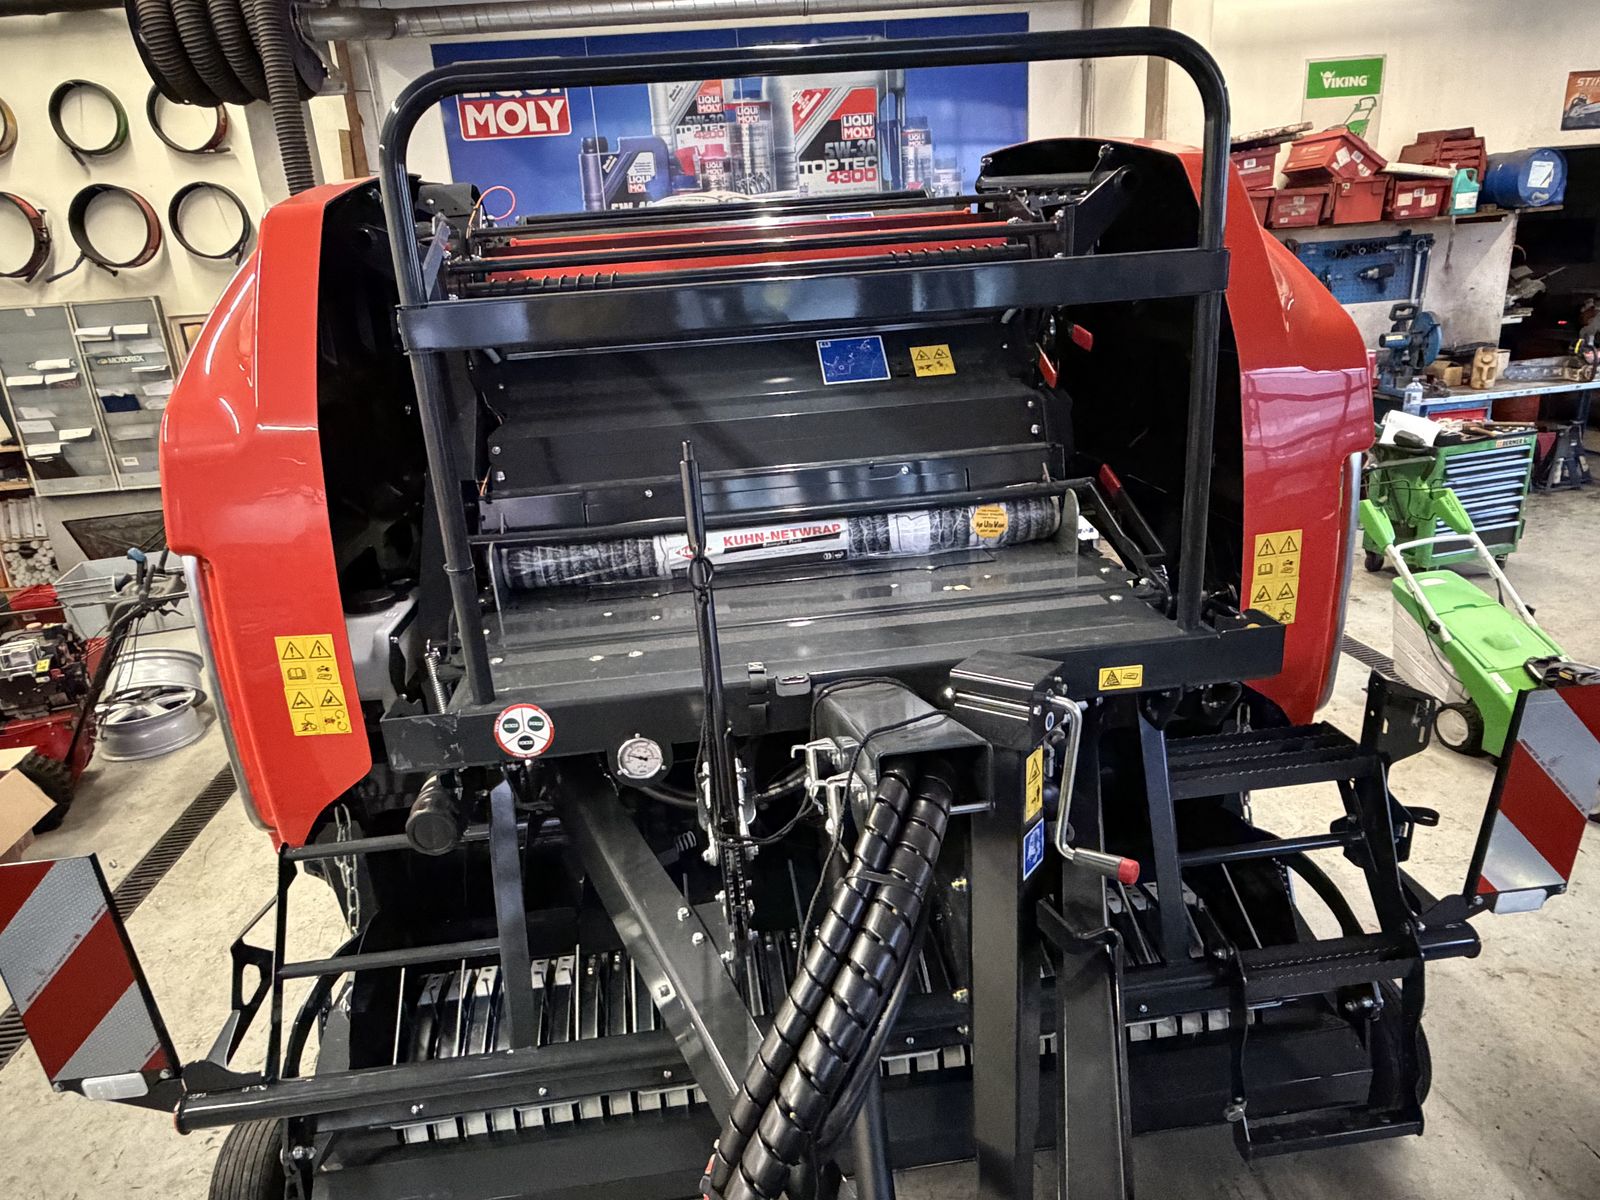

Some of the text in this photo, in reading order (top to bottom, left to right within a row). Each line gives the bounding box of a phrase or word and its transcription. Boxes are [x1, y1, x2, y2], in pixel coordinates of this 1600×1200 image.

[1322, 75, 1368, 89] VIKING
[698, 96, 720, 104] LIQUI
[697, 104, 721, 113] MOLY
[737, 107, 758, 115] LIQUI
[464, 99, 565, 136] MOLY
[685, 114, 724, 125] 5W-30
[737, 115, 760, 124] MOLY
[843, 114, 873, 127] LIQUI
[676, 123, 726, 135] TOP TEC
[844, 126, 874, 139] MOLY
[825, 140, 876, 158] 5W-30
[800, 156, 877, 175] TOP TEC
[827, 168, 877, 184] 4300
[108, 355, 145, 364] MOTOREX
[723, 523, 841, 547] KUHN-NETWRAP
